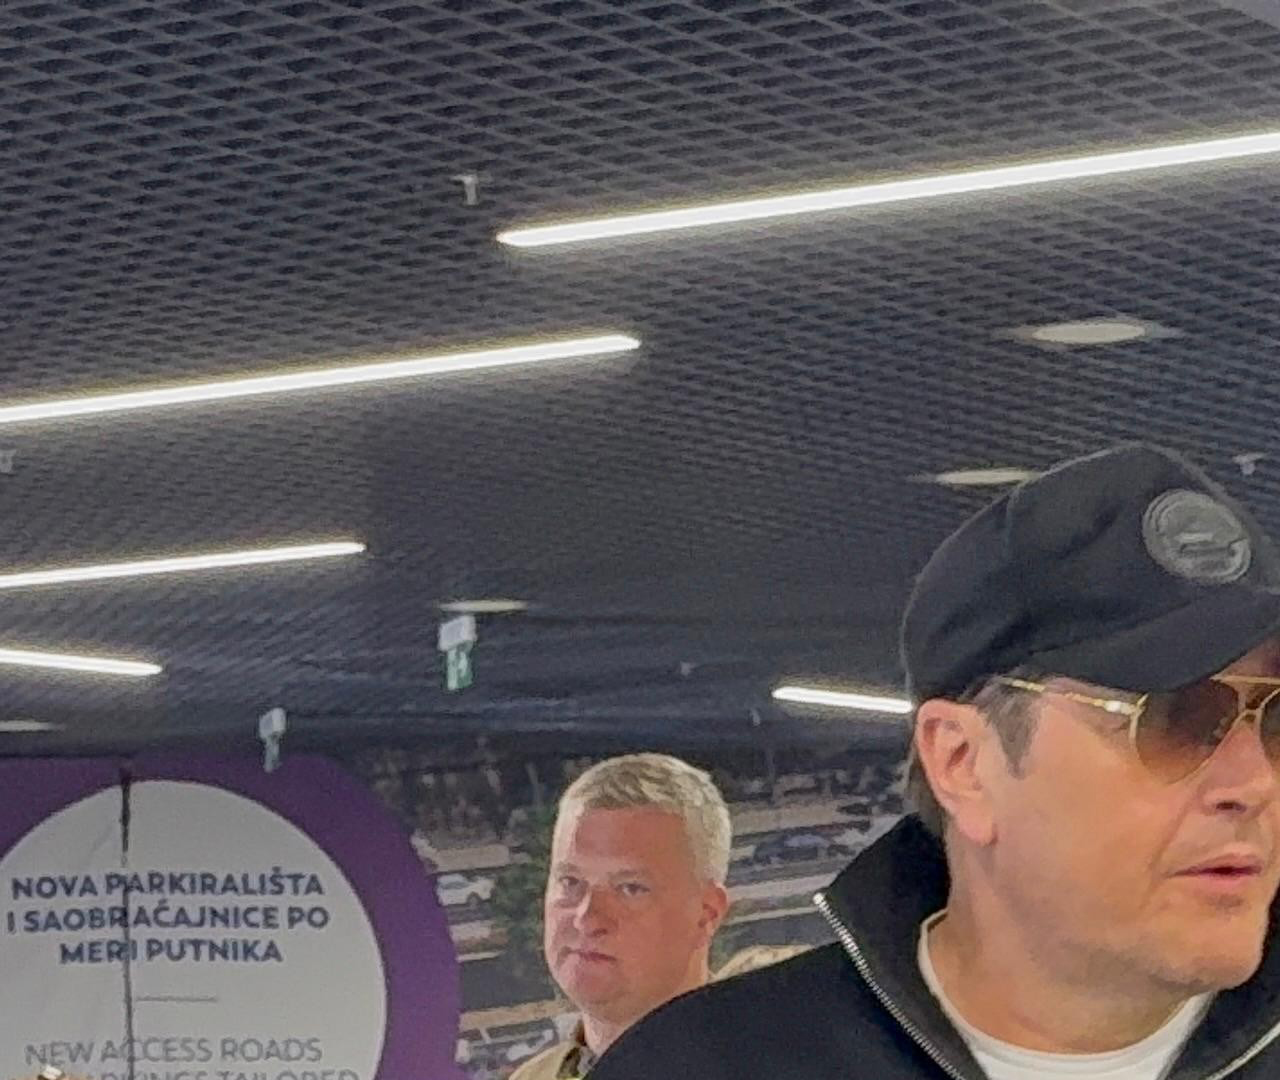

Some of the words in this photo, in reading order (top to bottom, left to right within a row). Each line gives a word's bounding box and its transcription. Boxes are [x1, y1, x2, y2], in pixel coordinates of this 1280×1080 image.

[11, 875, 98, 900] NOVA
[105, 867, 325, 896] PARKIRALIŠTA
[6, 911, 17, 934] I
[287, 904, 331, 929] PO
[59, 940, 138, 965] MERI
[146, 938, 284, 963] PUTNIKA
[24, 1041, 95, 1066] NEW
[100, 1037, 213, 1063] ACCESS
[220, 1036, 324, 1062] ROADS
